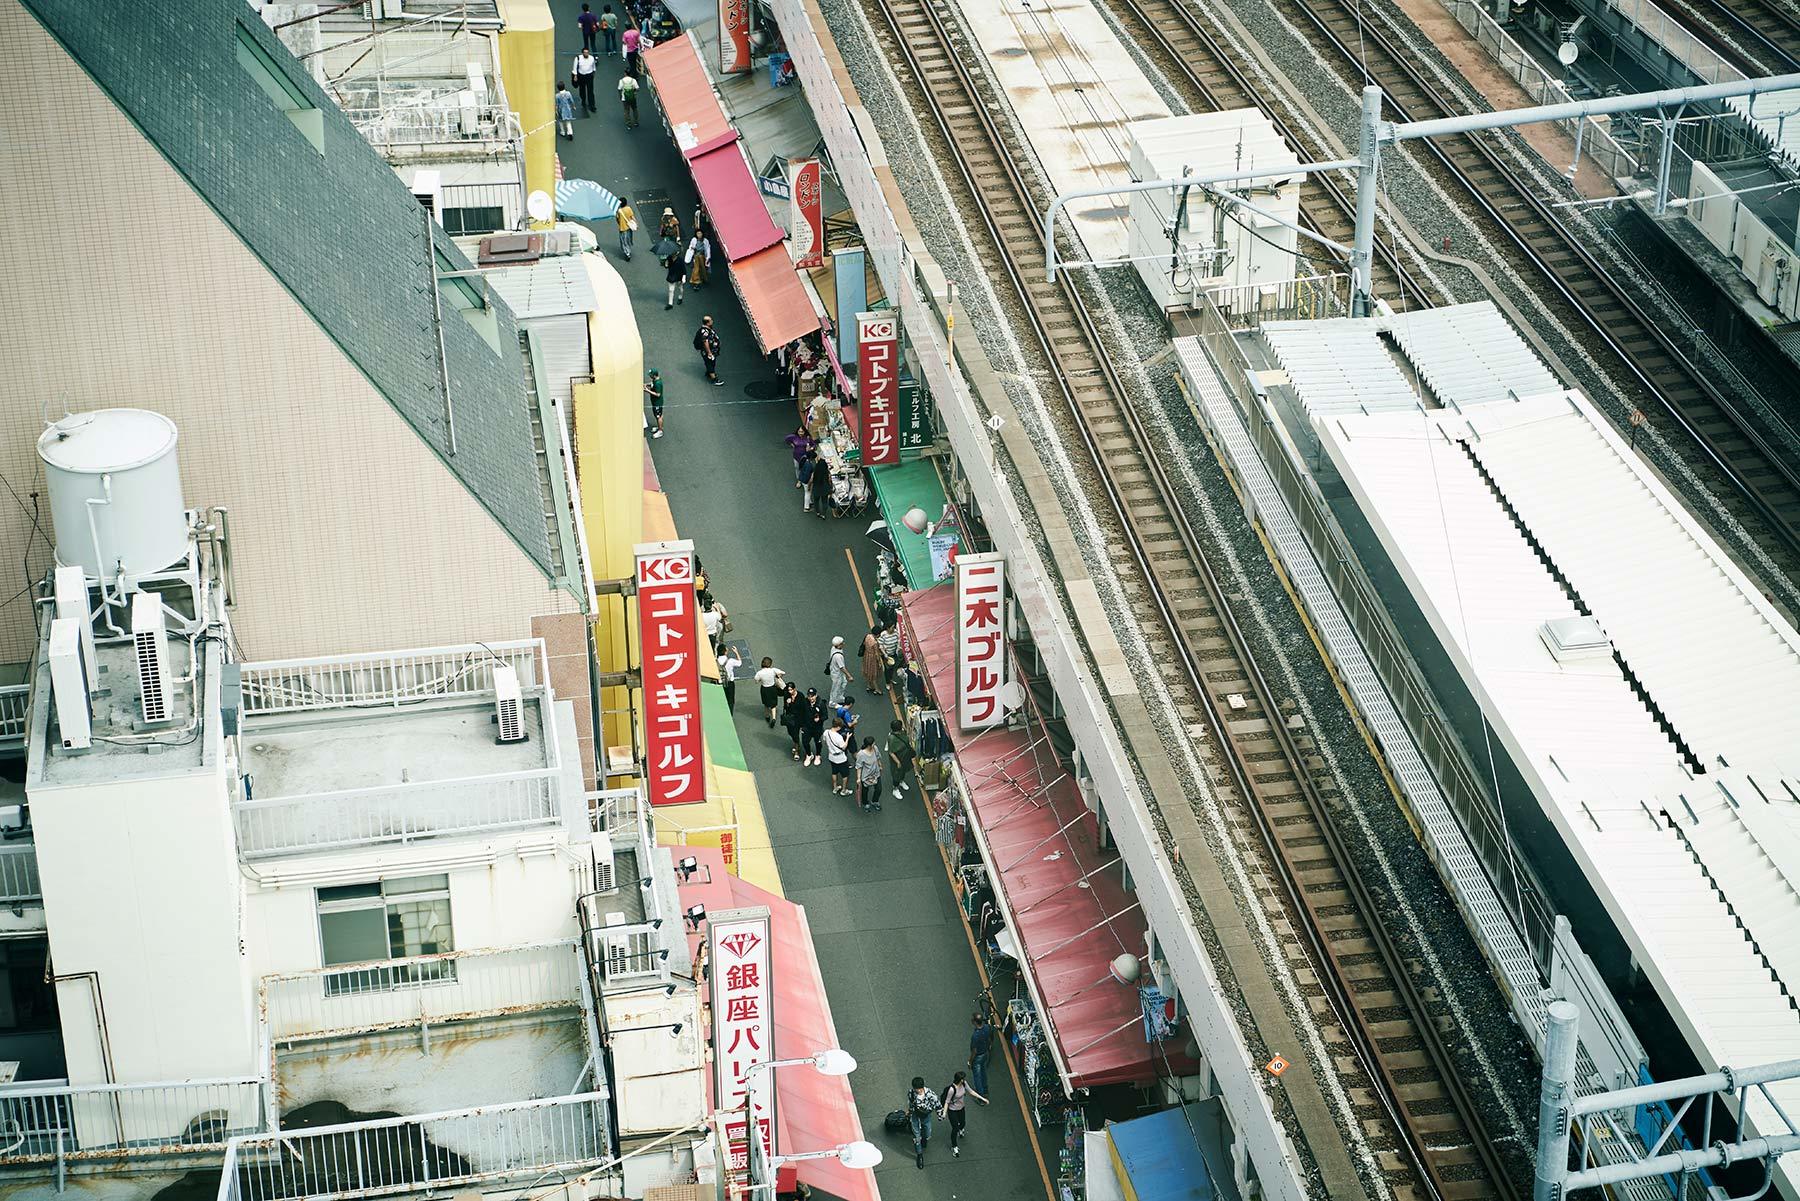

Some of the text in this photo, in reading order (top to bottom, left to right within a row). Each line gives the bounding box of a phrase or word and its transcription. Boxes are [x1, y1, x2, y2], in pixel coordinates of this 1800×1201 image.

[799, 173, 811, 210] ロンドン
[868, 344, 892, 461] コトブキゴルフ
[910, 433, 922, 444] 北
[640, 557, 691, 582] KG
[966, 567, 1000, 722] 二木ゴルフ
[651, 591, 694, 799] コトブキゴルフ
[720, 832, 734, 865] 御徒町
[1274, 1062, 1283, 1070] 10
